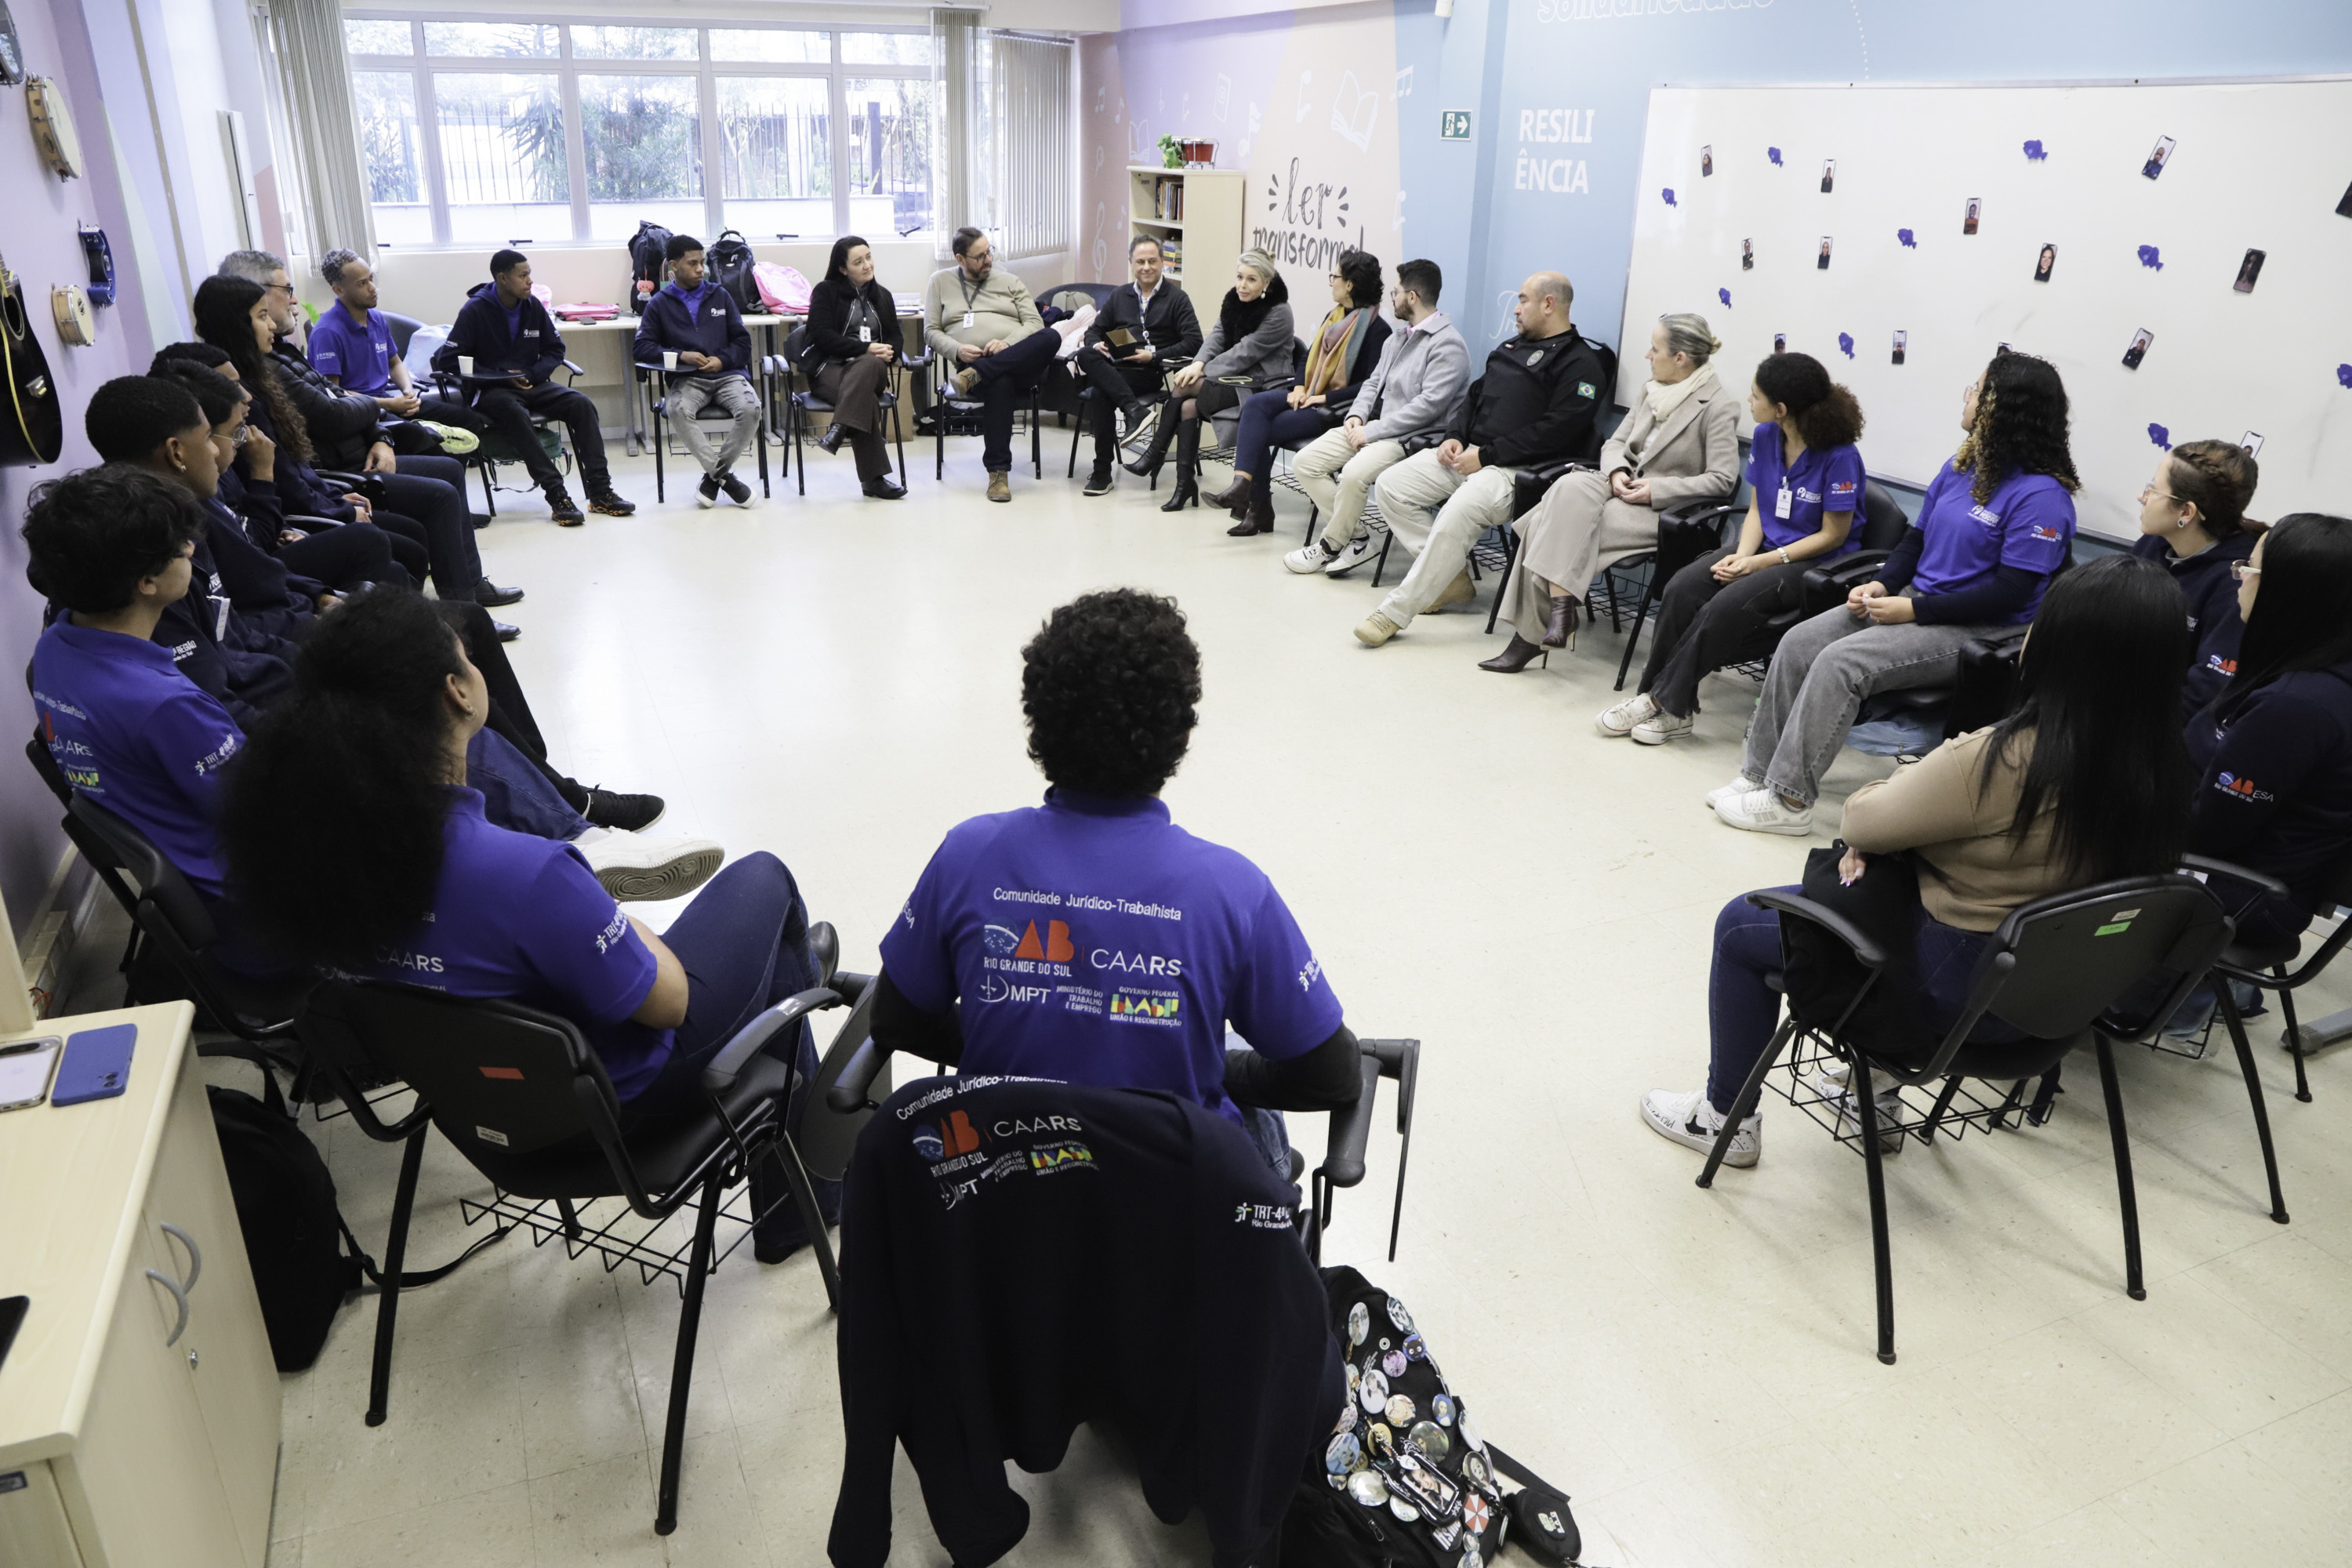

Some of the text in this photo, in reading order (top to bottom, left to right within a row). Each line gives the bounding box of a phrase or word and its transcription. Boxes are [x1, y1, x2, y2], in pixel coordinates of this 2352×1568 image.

[1537, 0, 1775, 23] solidarie
[1519, 108, 1595, 143] RESILI
[1515, 147, 1588, 194] ÊNCIA
[1282, 157, 1333, 229] ler
[2252, 789, 2274, 803] ESA
[993, 887, 1181, 920] Comunidade Jurídico-Trabalhista
[375, 946, 445, 973] CAARS
[984, 956, 1073, 977] RIO GRANDE DO SUL
[1091, 949, 1182, 976] CAARS
[1011, 985, 1051, 1004] MPT
[1056, 985, 1093, 996] MINISTÉRIO
[1069, 994, 1102, 1006] TRABALHO
[1119, 986, 1179, 998] GOVERNO FEDERAL
[1071, 1002, 1102, 1014] EMPREGO
[1109, 1014, 1129, 1022] UNIÃO
[1134, 1017, 1181, 1027] RECONSTRUÇÃO
[897, 1087, 953, 1120] Comunidade
[994, 1116, 1082, 1137] CAARS
[931, 1166, 943, 1178] RIO
[971, 1151, 989, 1167] SUL
[1252, 1218, 1263, 1228] Rio
